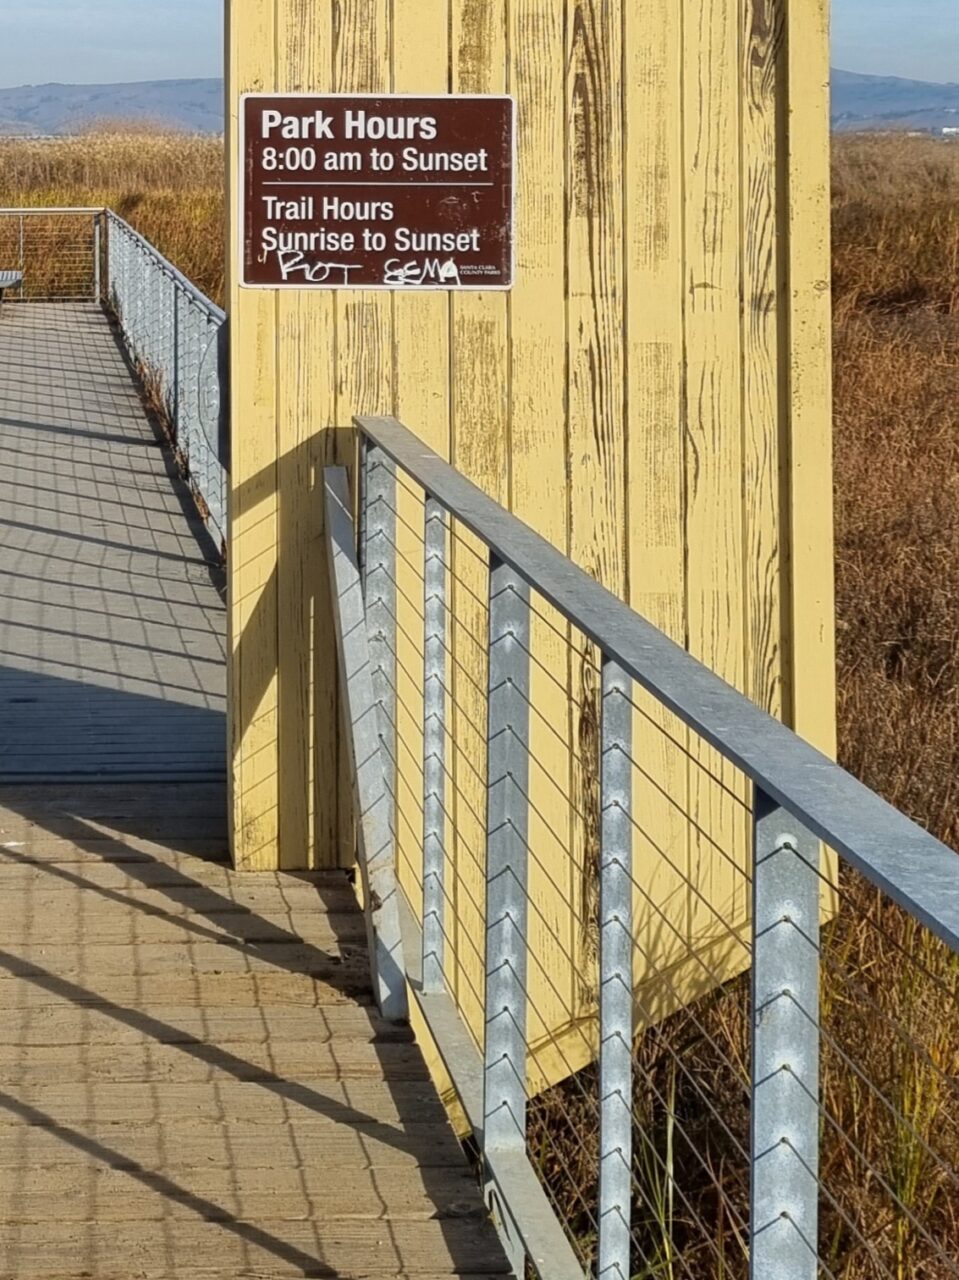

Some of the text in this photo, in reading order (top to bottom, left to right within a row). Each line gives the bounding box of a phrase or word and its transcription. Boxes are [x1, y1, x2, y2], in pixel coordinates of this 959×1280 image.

[261, 109, 437, 140] Park Hours
[262, 146, 488, 171] 8:00 am to Sunset
[262, 196, 394, 221] Trail Hours
[261, 228, 480, 252] Sunrise to Sunset
